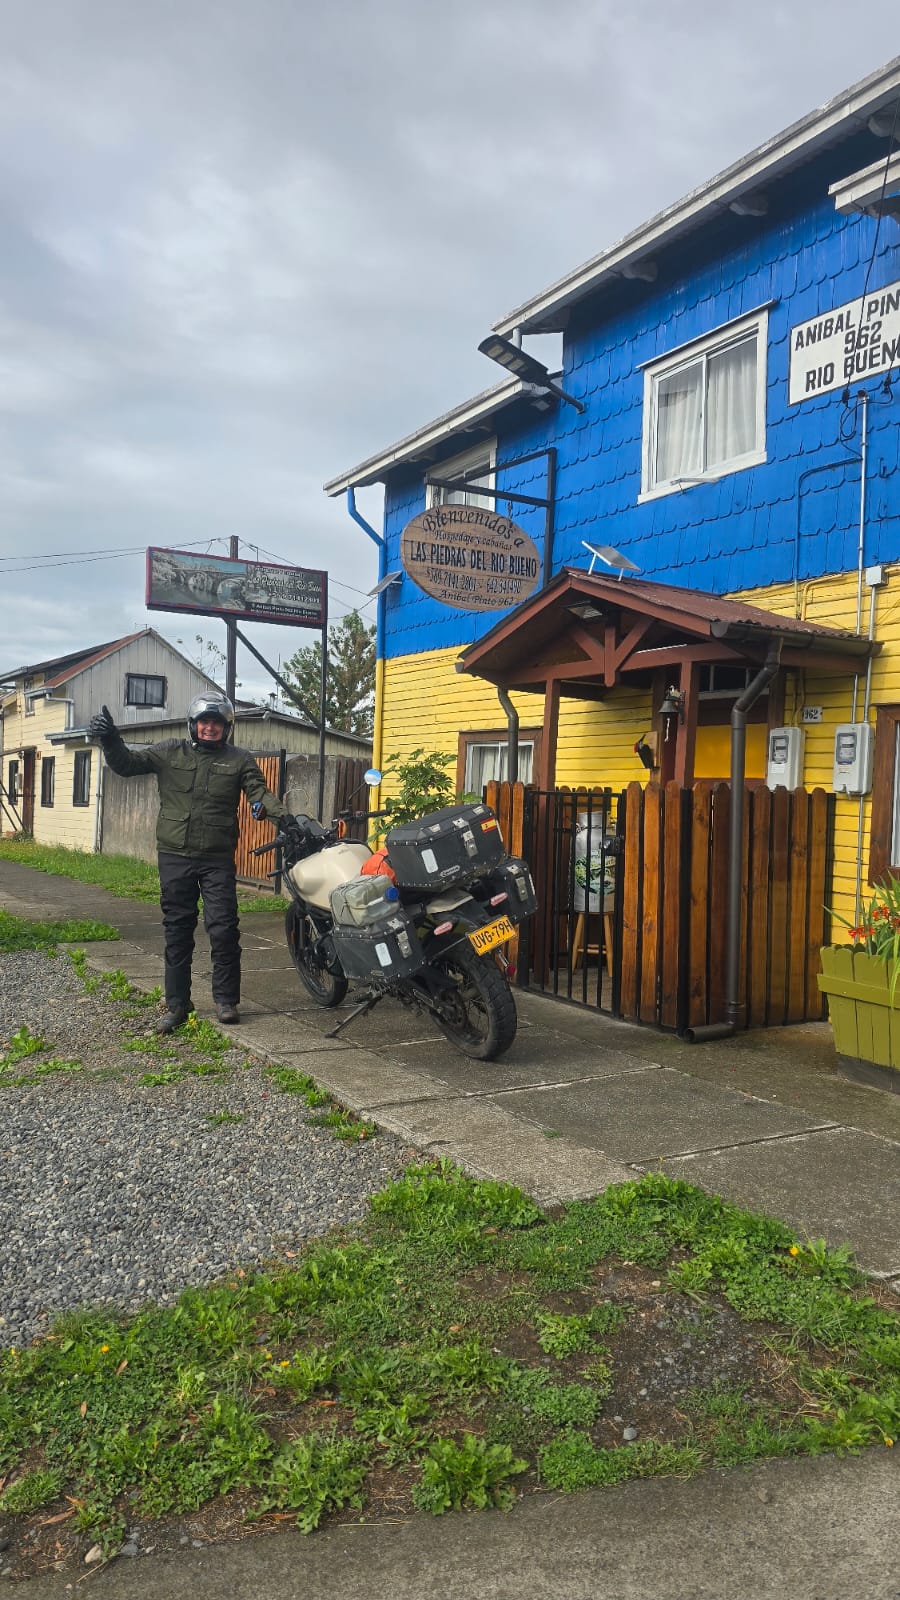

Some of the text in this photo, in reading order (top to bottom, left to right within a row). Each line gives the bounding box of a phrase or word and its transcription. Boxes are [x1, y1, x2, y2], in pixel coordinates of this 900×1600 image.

[795, 288, 900, 351] ANIBAL PIN
[844, 321, 882, 354] 962
[805, 362, 835, 392] RIO
[422, 509, 525, 548] Bienvenidos a
[434, 530, 474, 546] Hospedaje
[410, 540, 537, 578] LAS PIEDRAS DEL RIO BUENO
[438, 589, 469, 602] Anibal
[471, 593, 497, 606] Pinto
